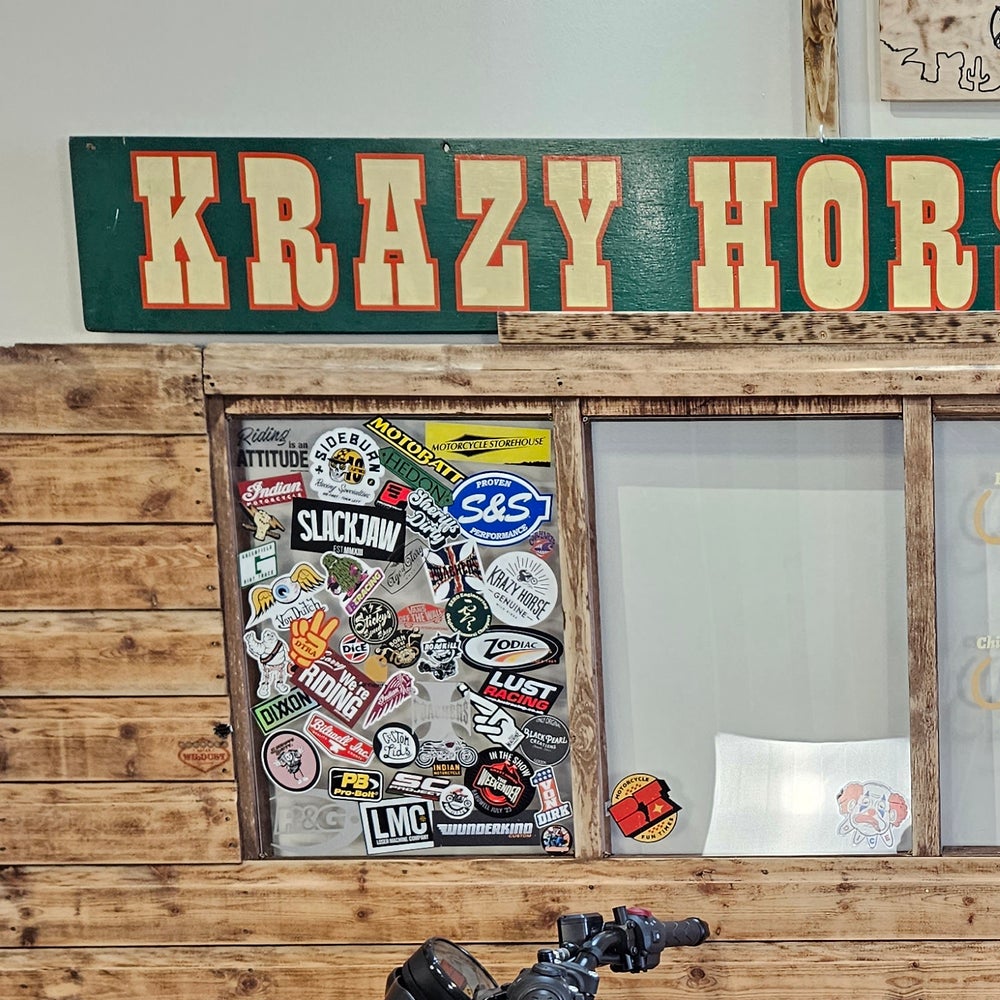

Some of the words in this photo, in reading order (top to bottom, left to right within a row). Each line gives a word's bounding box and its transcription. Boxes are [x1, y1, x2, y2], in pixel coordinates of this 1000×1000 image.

[130, 151, 622, 312] KRAZY
[238, 427, 290, 447] Riding
[288, 441, 296, 449] is
[431, 439, 488, 452] MOTORCYCLE
[489, 437, 544, 449] STOREHOUSE
[237, 449, 309, 468] ATTITUDE
[315, 432, 381, 473] SIDEBURN
[370, 417, 465, 484] MOTOBATT
[384, 451, 447, 503] HEDON
[476, 478, 512, 488] PROVEN
[242, 480, 302, 502] Indian
[246, 493, 302, 507] MOTORCYCLE
[458, 492, 534, 524] S&S
[297, 509, 401, 553] SLACKJAW
[469, 523, 529, 541] PERFORMANCE
[486, 564, 522, 596] KRAZY
[517, 588, 551, 621] HORSE
[292, 597, 321, 622] Dutch
[493, 591, 528, 620] GENUINE
[294, 640, 317, 657] DTRA
[484, 638, 538, 660] ZODIAC
[297, 663, 364, 720] RIDING
[341, 669, 370, 701] We're
[483, 684, 550, 711] RACING
[488, 670, 557, 700] LUST
[259, 691, 313, 726] DIXXON
[311, 718, 350, 746] Biltwell
[433, 763, 460, 771] INDIAN
[489, 751, 498, 760] IN
[499, 750, 514, 763] THE
[511, 756, 532, 778] SHOW
[341, 772, 370, 790] PB
[391, 774, 450, 791] SC
[476, 768, 522, 804] WEEKENDER
[615, 776, 650, 800] MOTORCYCLE
[371, 804, 428, 839] LMC
[536, 803, 571, 826] DIRK
[658, 817, 674, 836] TIMES
[437, 822, 534, 836] WUNDERKIND
